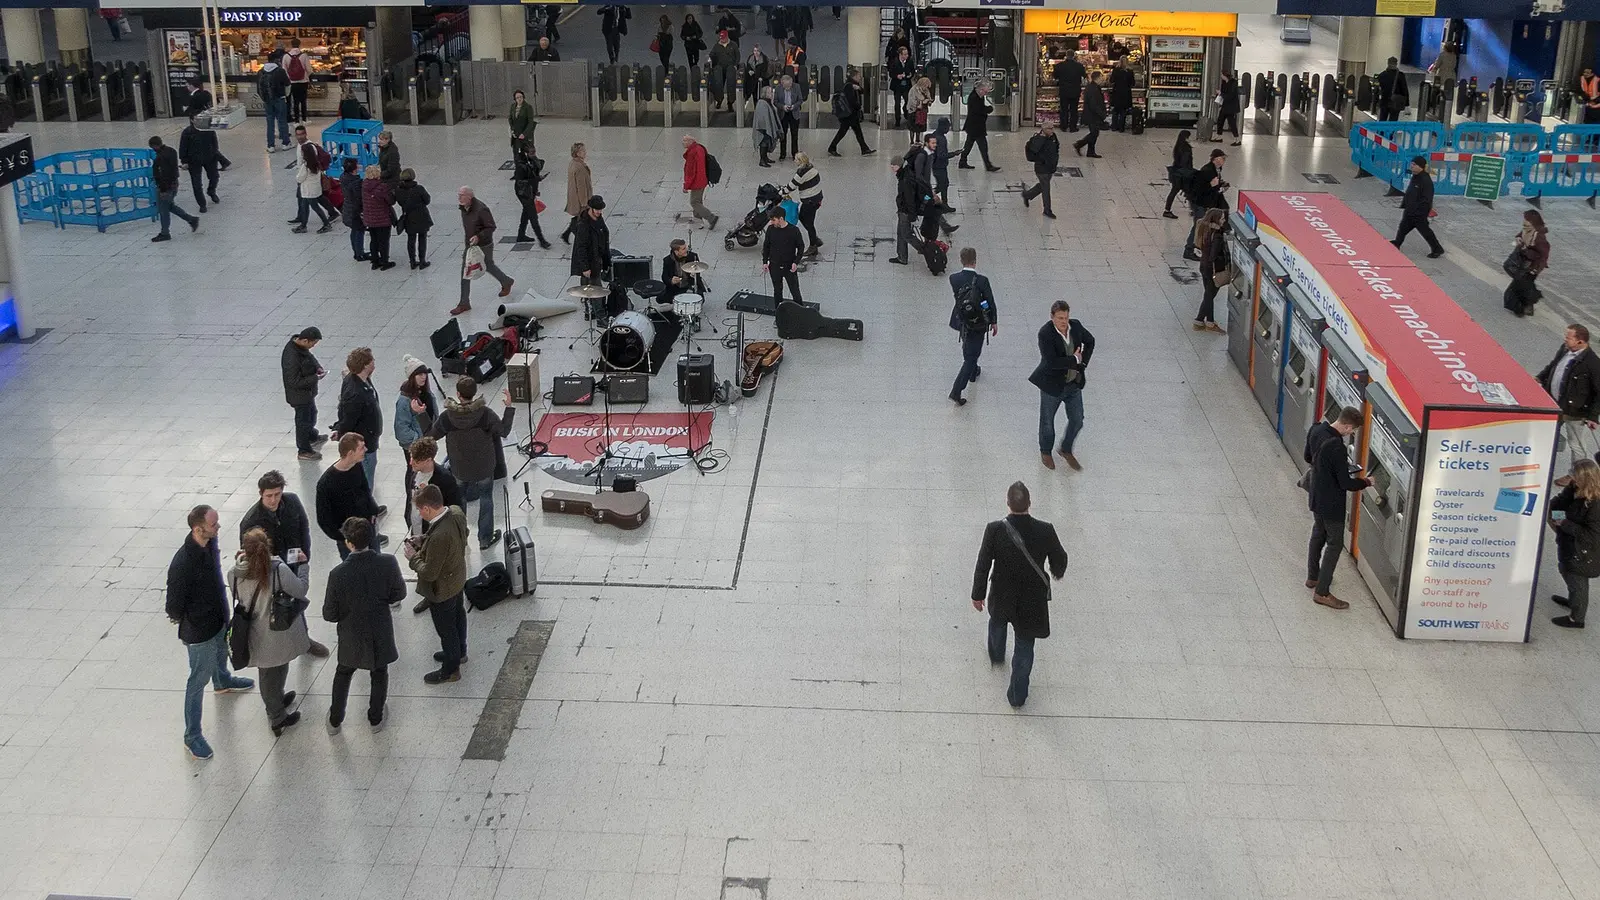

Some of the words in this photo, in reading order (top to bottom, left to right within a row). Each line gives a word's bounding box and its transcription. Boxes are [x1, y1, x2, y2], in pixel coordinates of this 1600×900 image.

[223, 12, 264, 22] PASTY
[267, 11, 302, 22] SHOP
[1065, 12, 1104, 31] Upper
[1100, 14, 1138, 29] Crust
[1281, 246, 1321, 302] Self-service
[1322, 296, 1349, 335] tickets
[1281, 195, 1357, 256] Self-service
[1348, 259, 1404, 300] ticket
[1389, 304, 1480, 394] machines
[554, 427, 600, 437] BUSK
[603, 427, 620, 437] IN
[622, 426, 690, 437] LONDON
[1440, 439, 1532, 455] Self-service
[1438, 457, 1490, 471] tickets
[1435, 488, 1485, 498] Travelcards
[1433, 500, 1464, 510] Oyster
[1432, 512, 1464, 521] Season
[1467, 513, 1498, 522] tickets
[1430, 524, 1479, 534] Groupsave
[1428, 536, 1468, 546] Pre-paid
[1471, 537, 1516, 547] collection
[1427, 547, 1464, 557] Railcard
[1466, 548, 1510, 558] discounts
[1425, 560, 1450, 568] Child
[1452, 560, 1496, 569] discounts
[1423, 576, 1441, 586] Any
[1443, 577, 1492, 587] questions?
[1422, 587, 1441, 596] Our
[1443, 588, 1464, 597] staff
[1420, 600, 1453, 608] around
[1455, 601, 1465, 609] to
[1467, 601, 1488, 610] help
[1418, 619, 1452, 628] SOUTH
[1453, 620, 1480, 629] WEST
[1481, 619, 1510, 630] TRAINS
